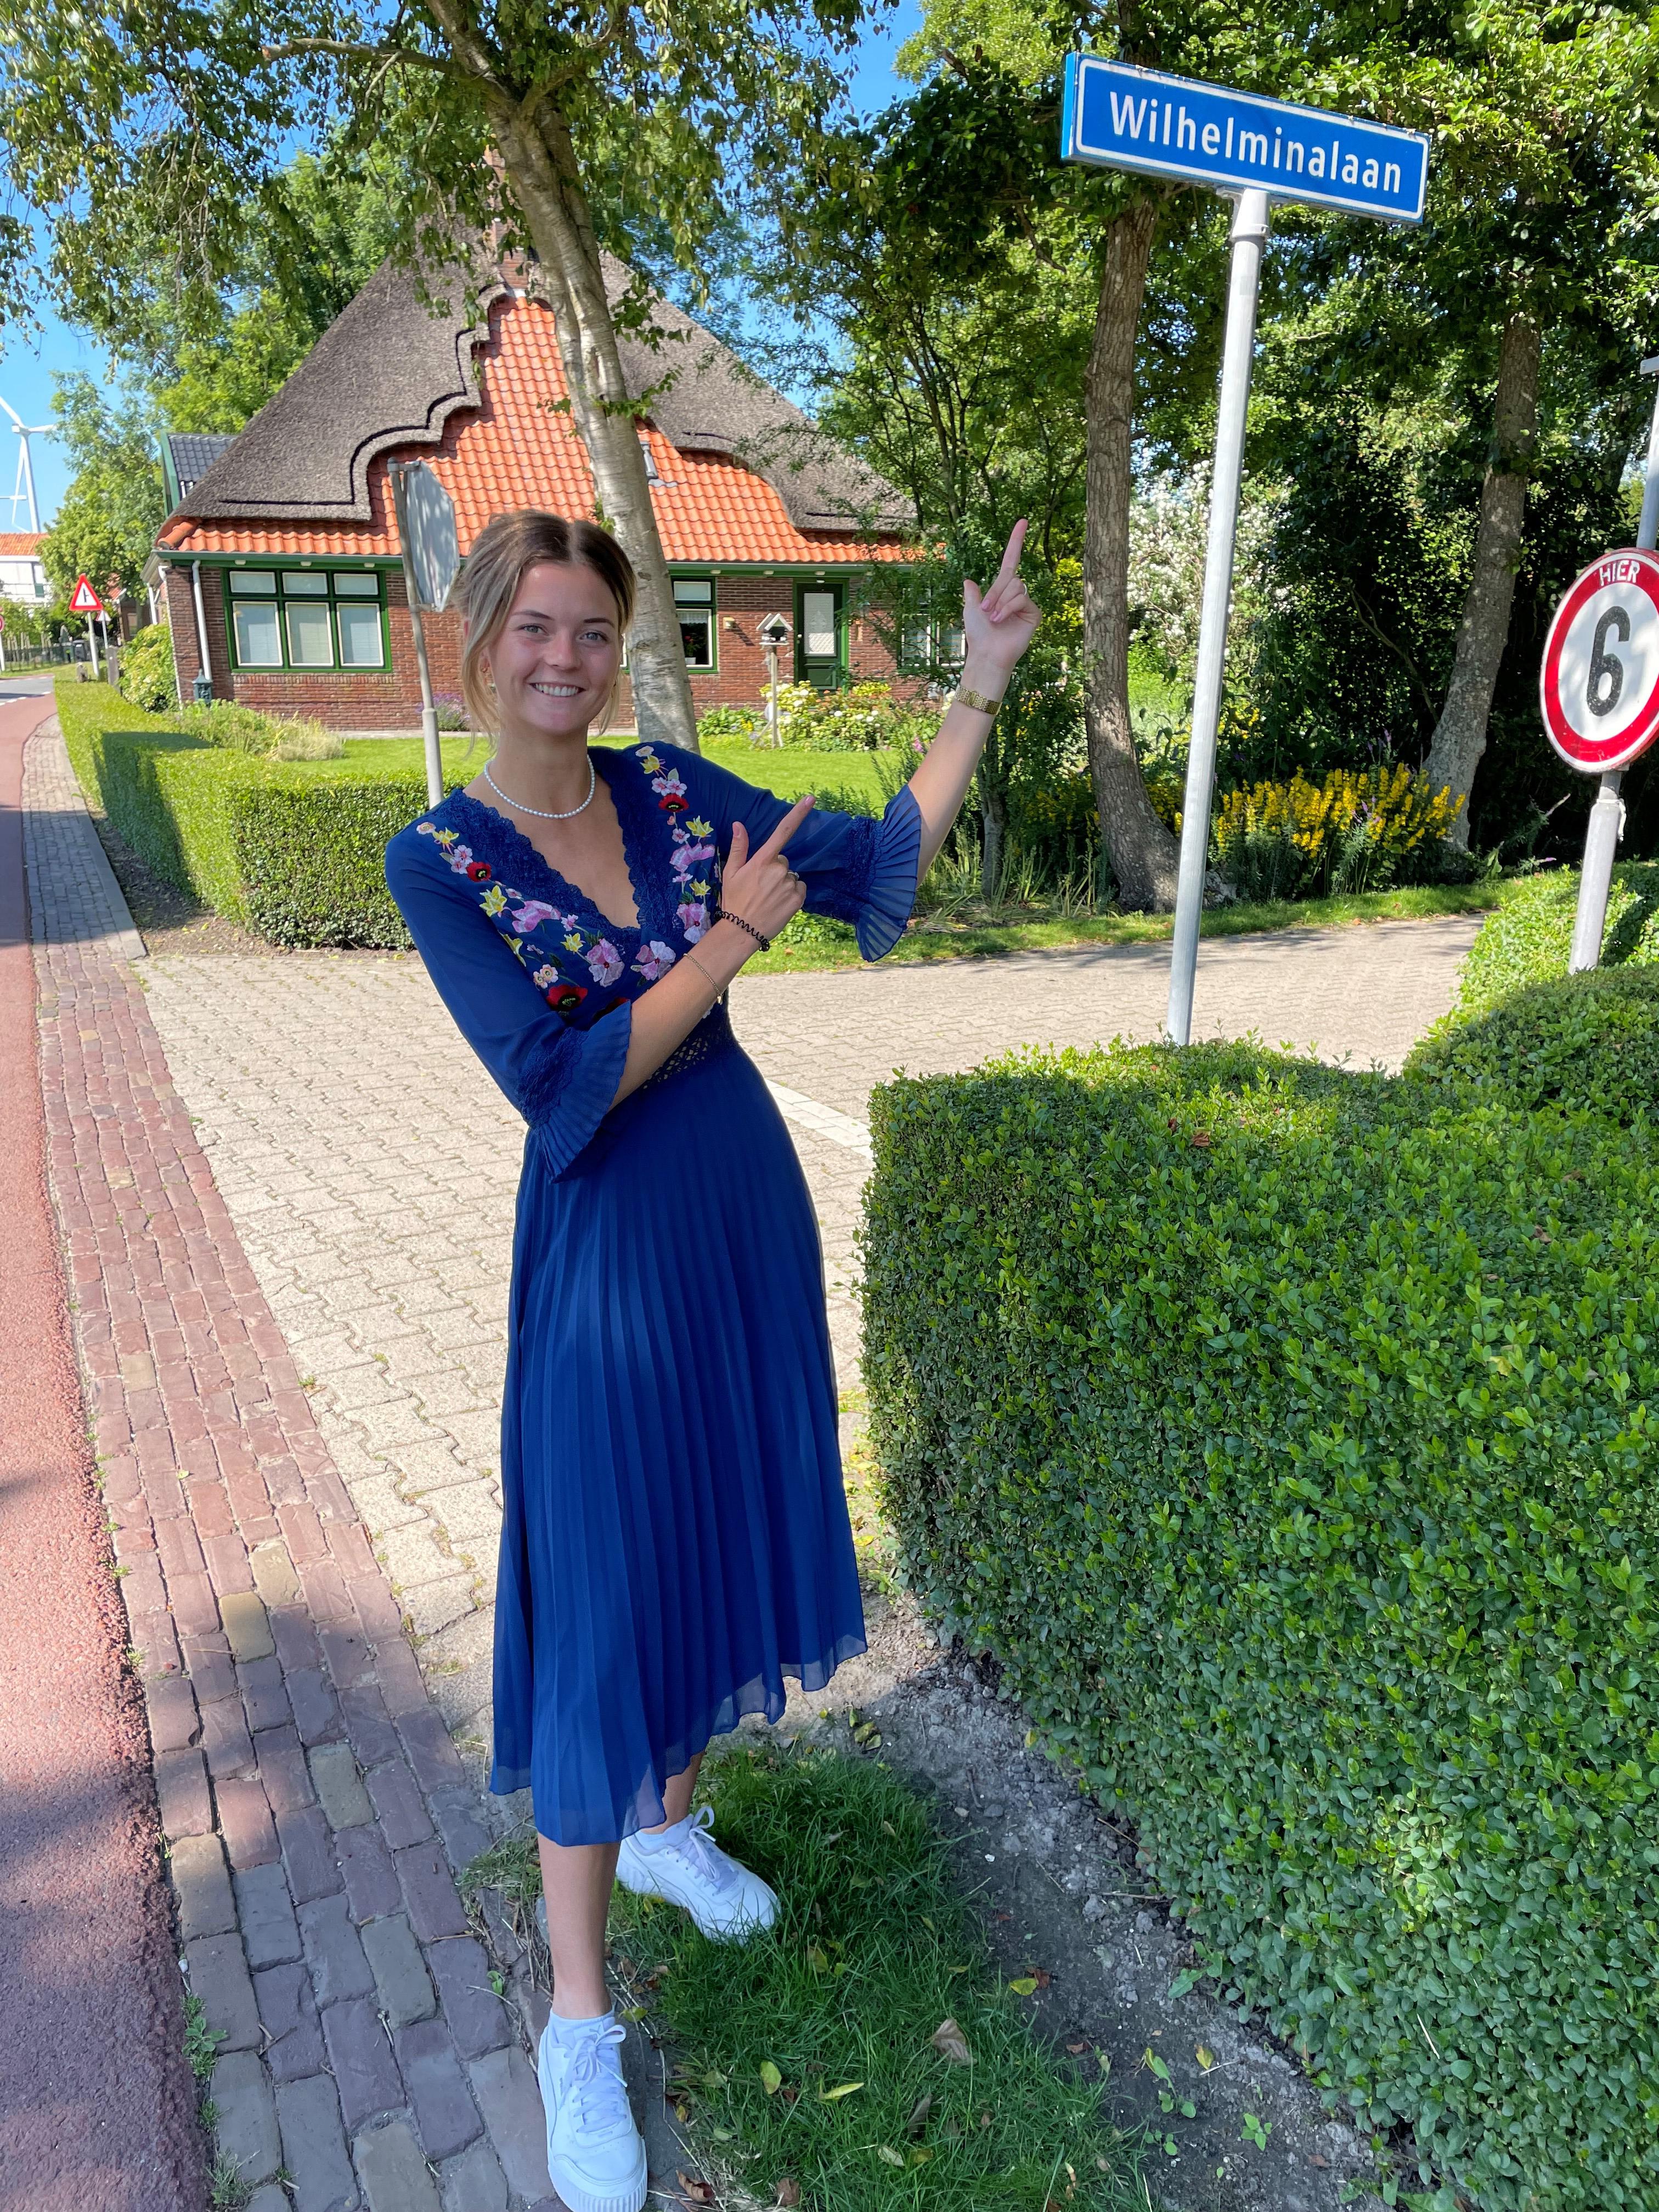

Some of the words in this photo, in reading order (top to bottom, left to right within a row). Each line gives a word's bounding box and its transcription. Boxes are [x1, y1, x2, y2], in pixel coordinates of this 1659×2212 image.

[1109, 91, 1401, 194] Wilhelminalaan
[1599, 560, 1640, 586] HIER
[1587, 606, 1630, 716] 6
